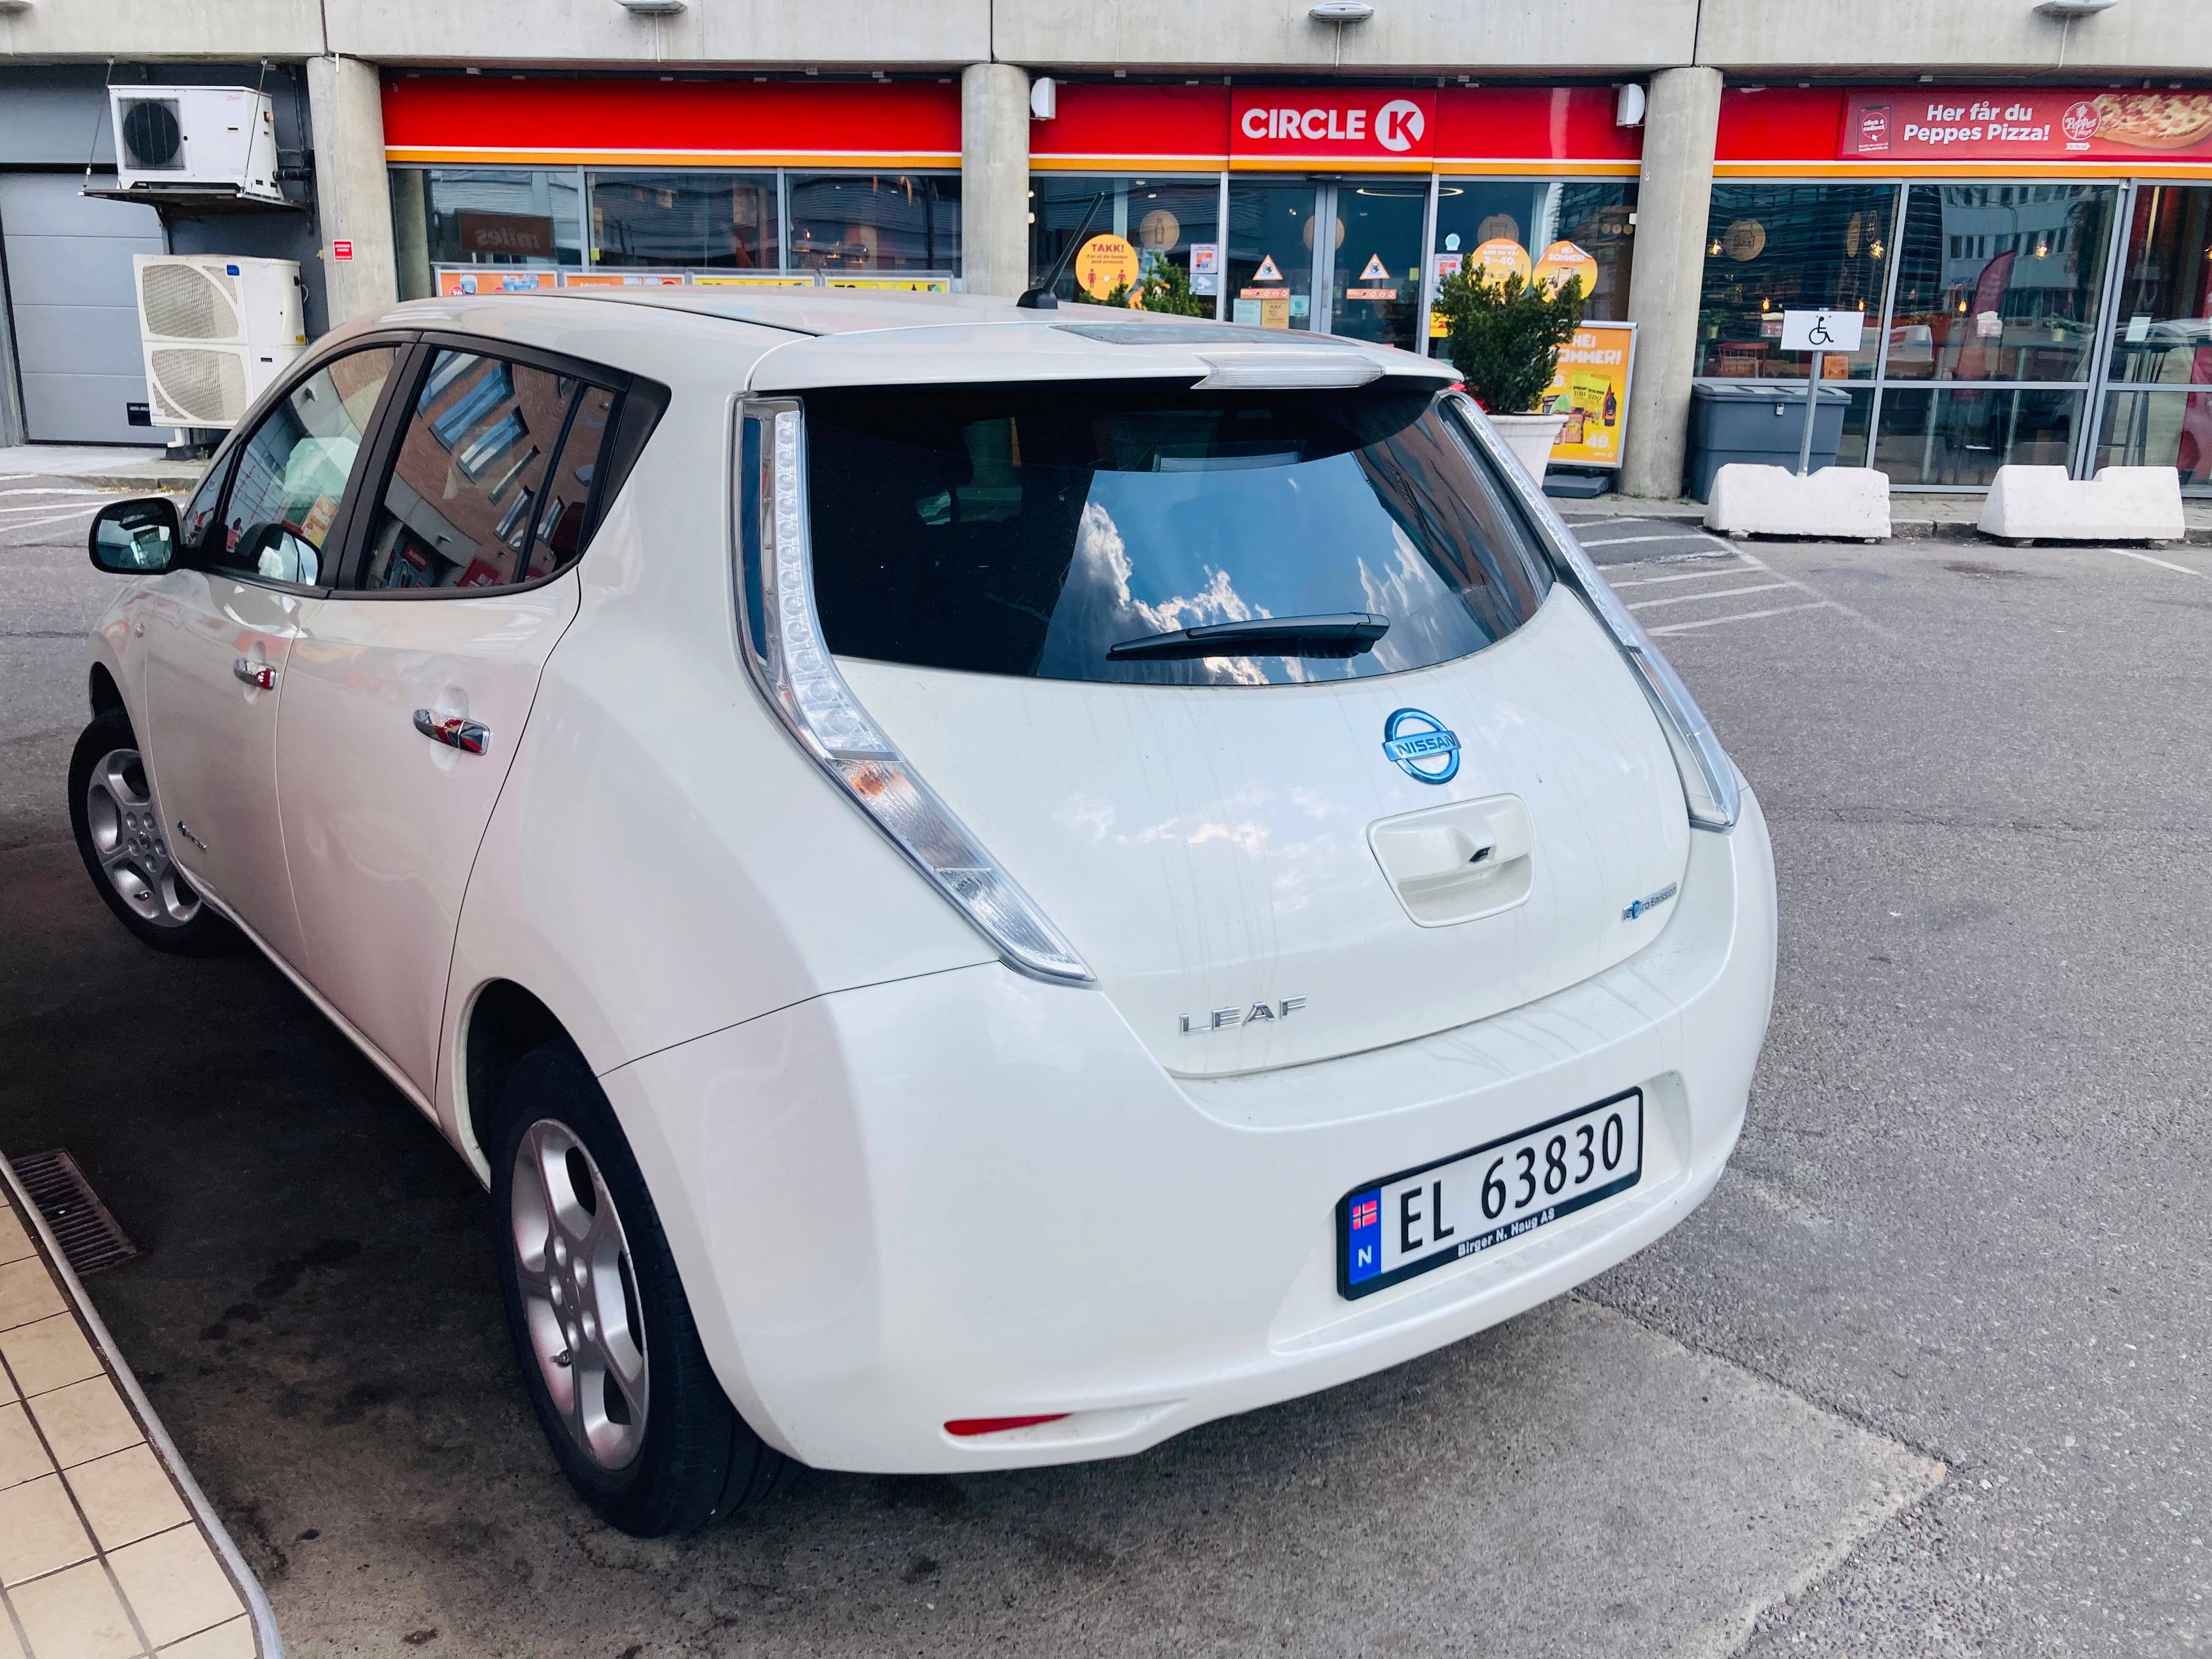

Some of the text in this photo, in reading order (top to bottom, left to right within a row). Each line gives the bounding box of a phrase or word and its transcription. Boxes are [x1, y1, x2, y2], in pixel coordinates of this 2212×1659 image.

[1926, 101, 2033, 121] Her får du
[1241, 109, 1366, 139] CIRCLE
[1904, 123, 2051, 144] Peppes Pizza!
[2065, 116, 2097, 130] Peppes
[1091, 244, 1124, 252] TAKK!
[1483, 256, 1491, 264] 2
[1556, 348, 1622, 365] OMMER!
[1396, 735, 1457, 755] NISSAN
[1651, 886, 1677, 907] Emission
[1180, 995, 1306, 1036] LEAF
[1400, 1113, 1623, 1254] EL 63830
[1458, 1207, 1555, 1257] Birger N. Haug AS
[1358, 1245, 1372, 1267] N
